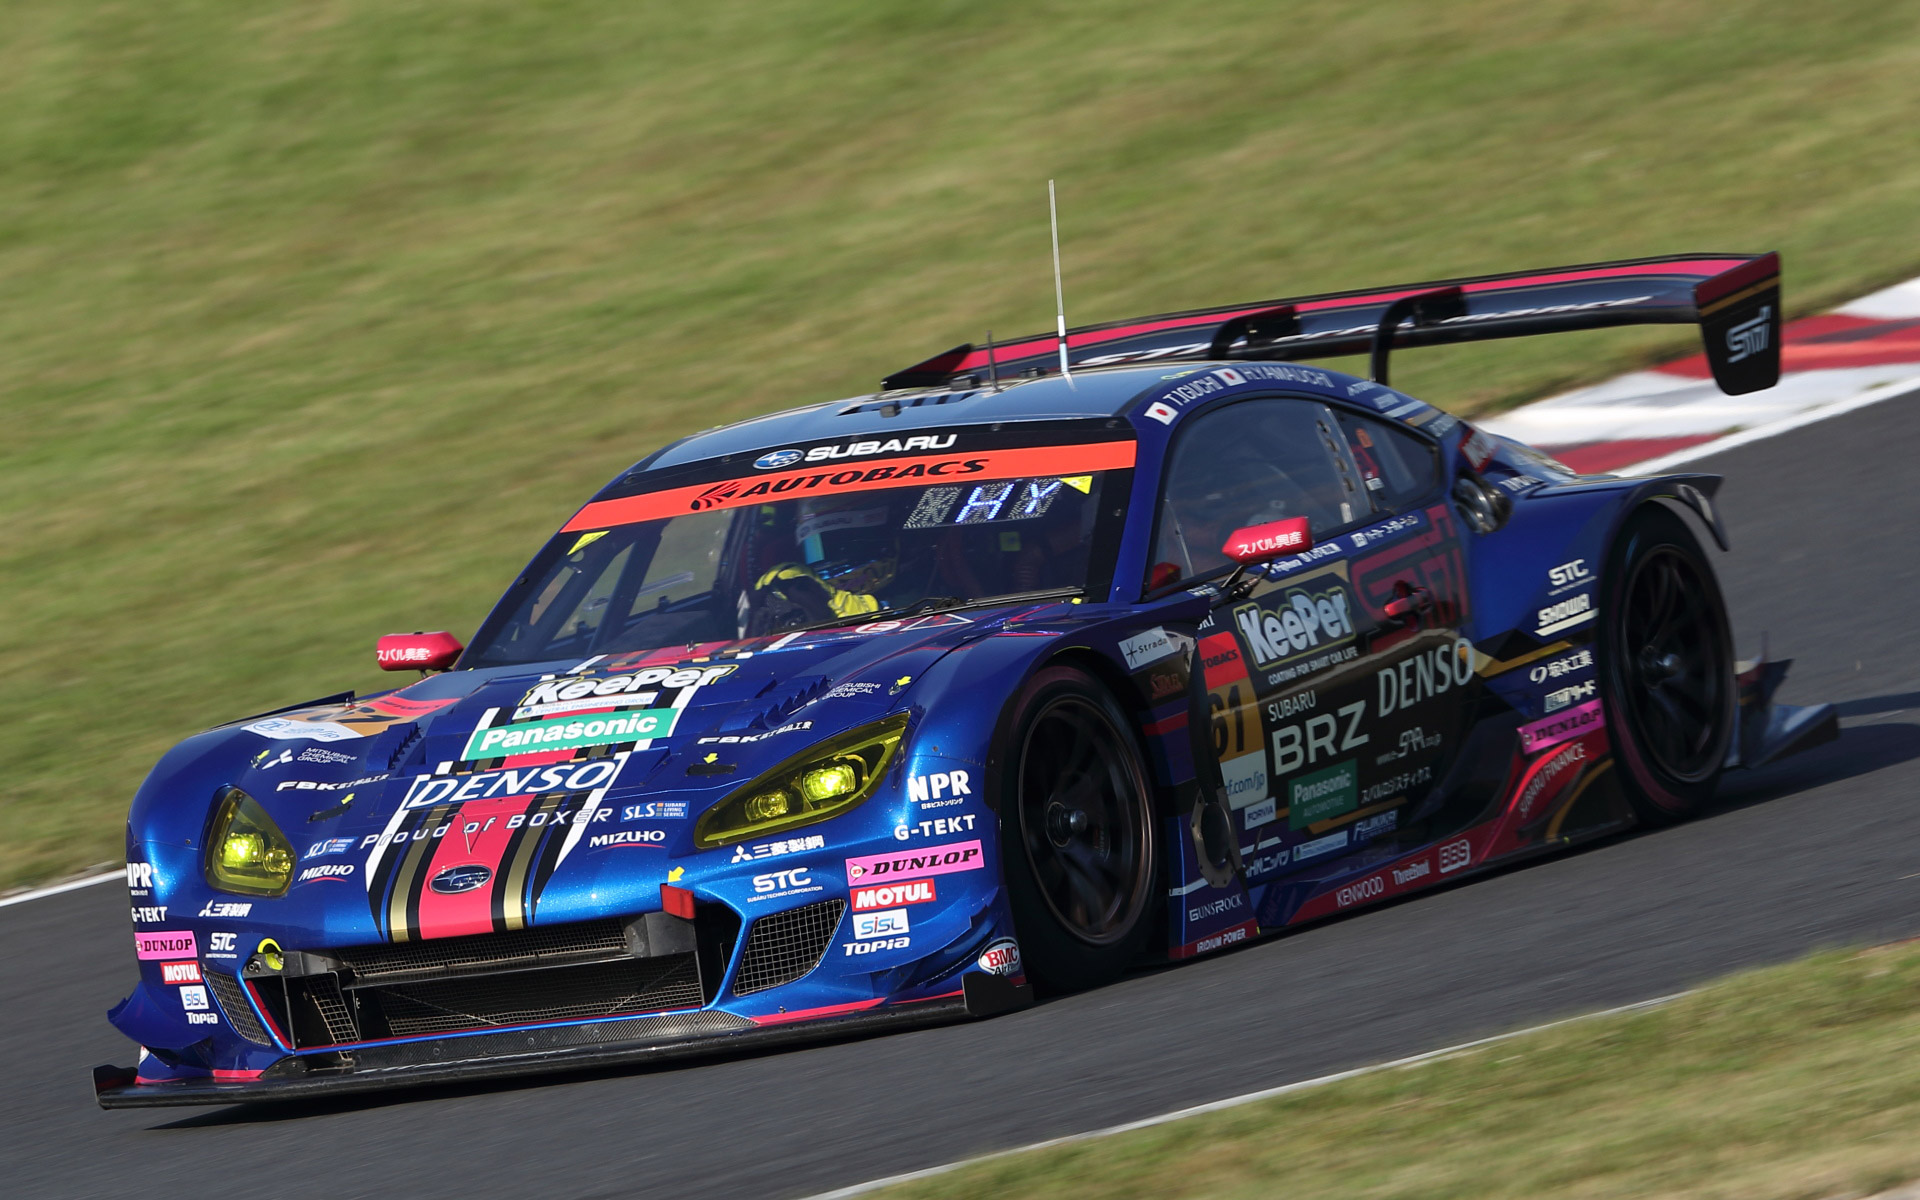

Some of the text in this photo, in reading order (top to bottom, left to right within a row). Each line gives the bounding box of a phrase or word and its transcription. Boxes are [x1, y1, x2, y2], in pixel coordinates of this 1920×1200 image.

[804, 434, 957, 463] SUBARU
[739, 458, 989, 498] AUTOBACS
[1238, 530, 1304, 557] スバル興産
[1548, 558, 1589, 586] STC
[1237, 589, 1352, 665] KeePer
[1138, 638, 1168, 654] Strada
[520, 666, 735, 707] KeePer
[1377, 637, 1475, 718] DENSO
[1268, 690, 1317, 722] SUBARU
[479, 712, 658, 752] Panasonic
[1272, 700, 1370, 776] BRZ
[405, 760, 616, 810] DENSO
[907, 770, 972, 803] NPR
[1294, 769, 1352, 805] Panasonic
[623, 803, 656, 820] SLS
[360, 822, 449, 850] Proud
[463, 817, 496, 833] of
[505, 806, 614, 830] BOXER
[589, 830, 666, 848] MIZUHO
[893, 814, 976, 841] G-TEKT
[303, 840, 333, 859] SLS
[871, 848, 979, 876] DUNLOP
[297, 864, 355, 882] MIZUHO
[752, 867, 812, 893] STC
[747, 894, 767, 903] SUBARU
[855, 882, 933, 909] MOTUL
[1336, 875, 1385, 908] KENWOOD
[131, 906, 168, 923] G-TEKT
[143, 938, 193, 952] DUNLOP
[210, 932, 238, 951] STC
[984, 946, 1018, 967] BMC
[163, 964, 201, 982] MOTUL
